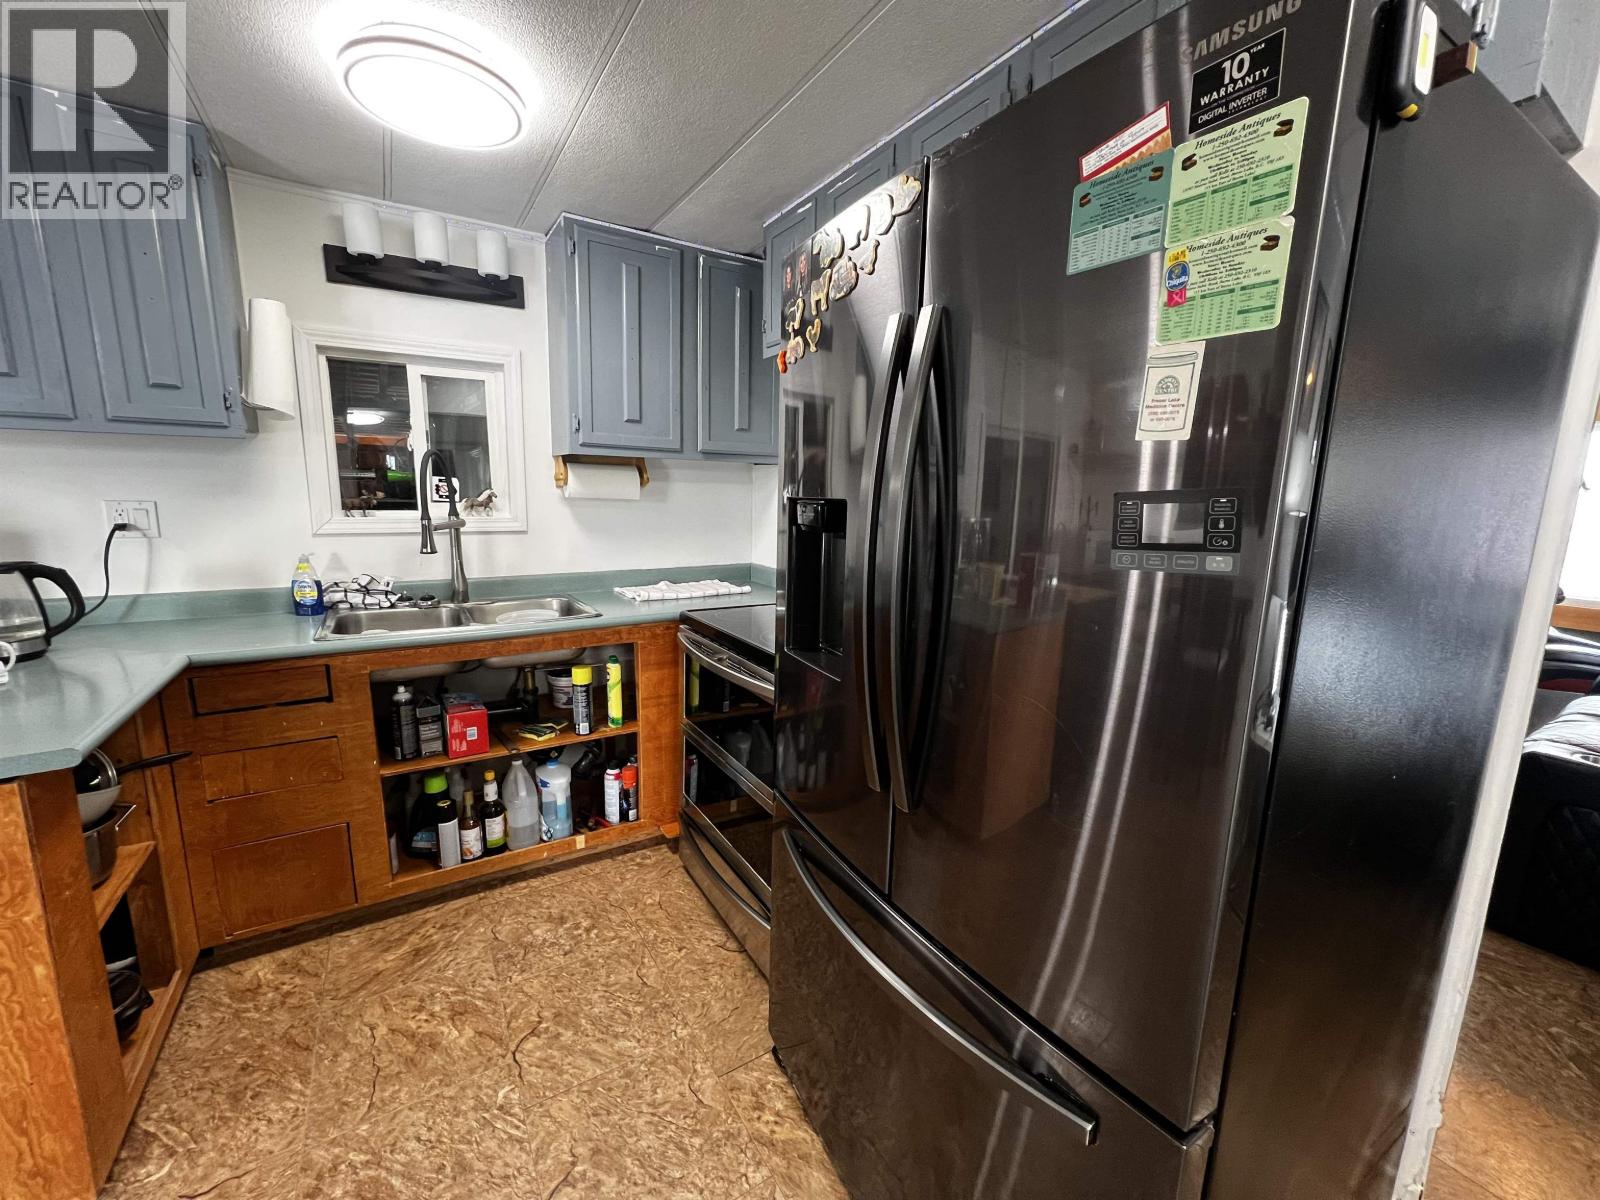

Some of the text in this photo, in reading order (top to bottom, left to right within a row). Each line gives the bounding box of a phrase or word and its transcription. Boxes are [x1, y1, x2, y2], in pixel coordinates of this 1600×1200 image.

[1181, 0, 1301, 64] SAMSUNG
[1221, 43, 1265, 85] 10 YEAR
[1198, 104, 1227, 124] DIGITAL
[1228, 87, 1267, 111] INVERTER
[1200, 66, 1269, 106] WARRANTY
[1194, 112, 1281, 150] Homeside Antiques
[1226, 227, 1268, 243] Antiques
